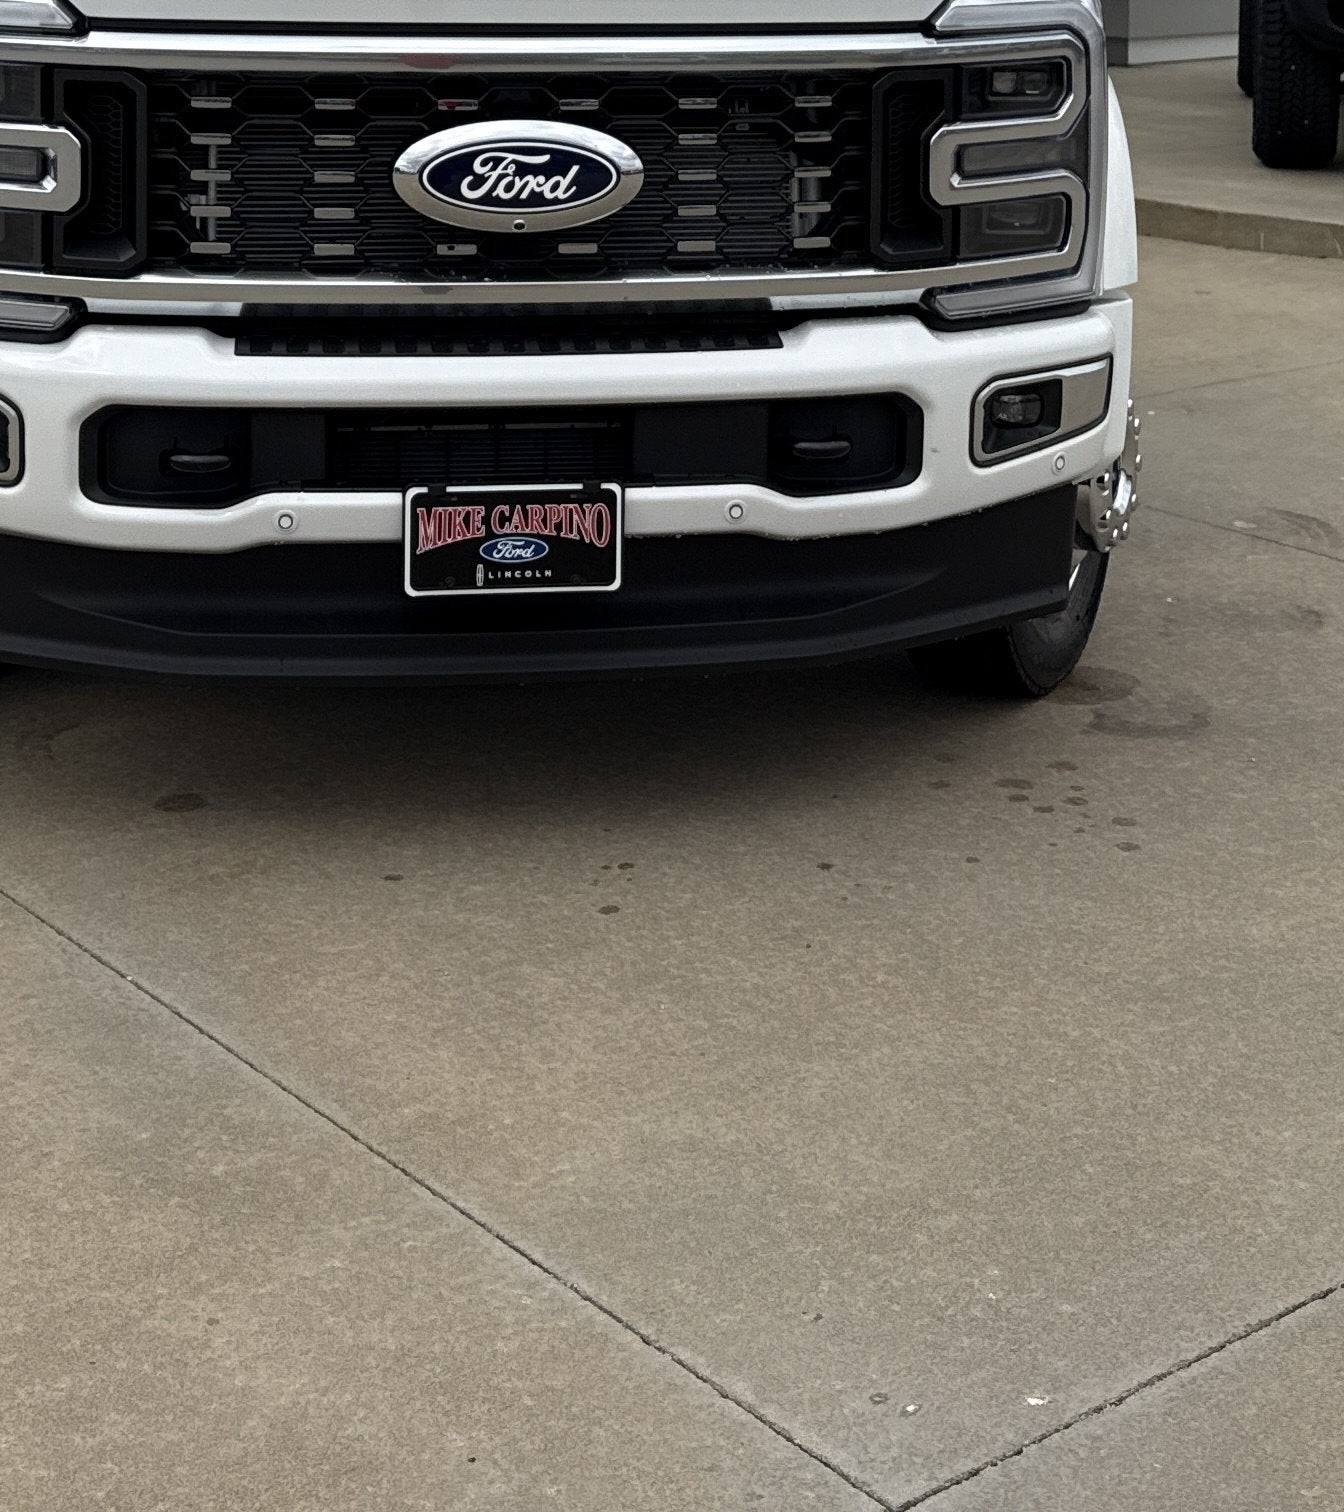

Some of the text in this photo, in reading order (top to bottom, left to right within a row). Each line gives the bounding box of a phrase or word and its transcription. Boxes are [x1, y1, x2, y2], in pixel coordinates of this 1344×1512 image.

[460, 151, 581, 200] Ford
[416, 502, 611, 555] MIKE CARPINO
[491, 540, 535, 559] Ford
[487, 569, 553, 580] LINCOLN
